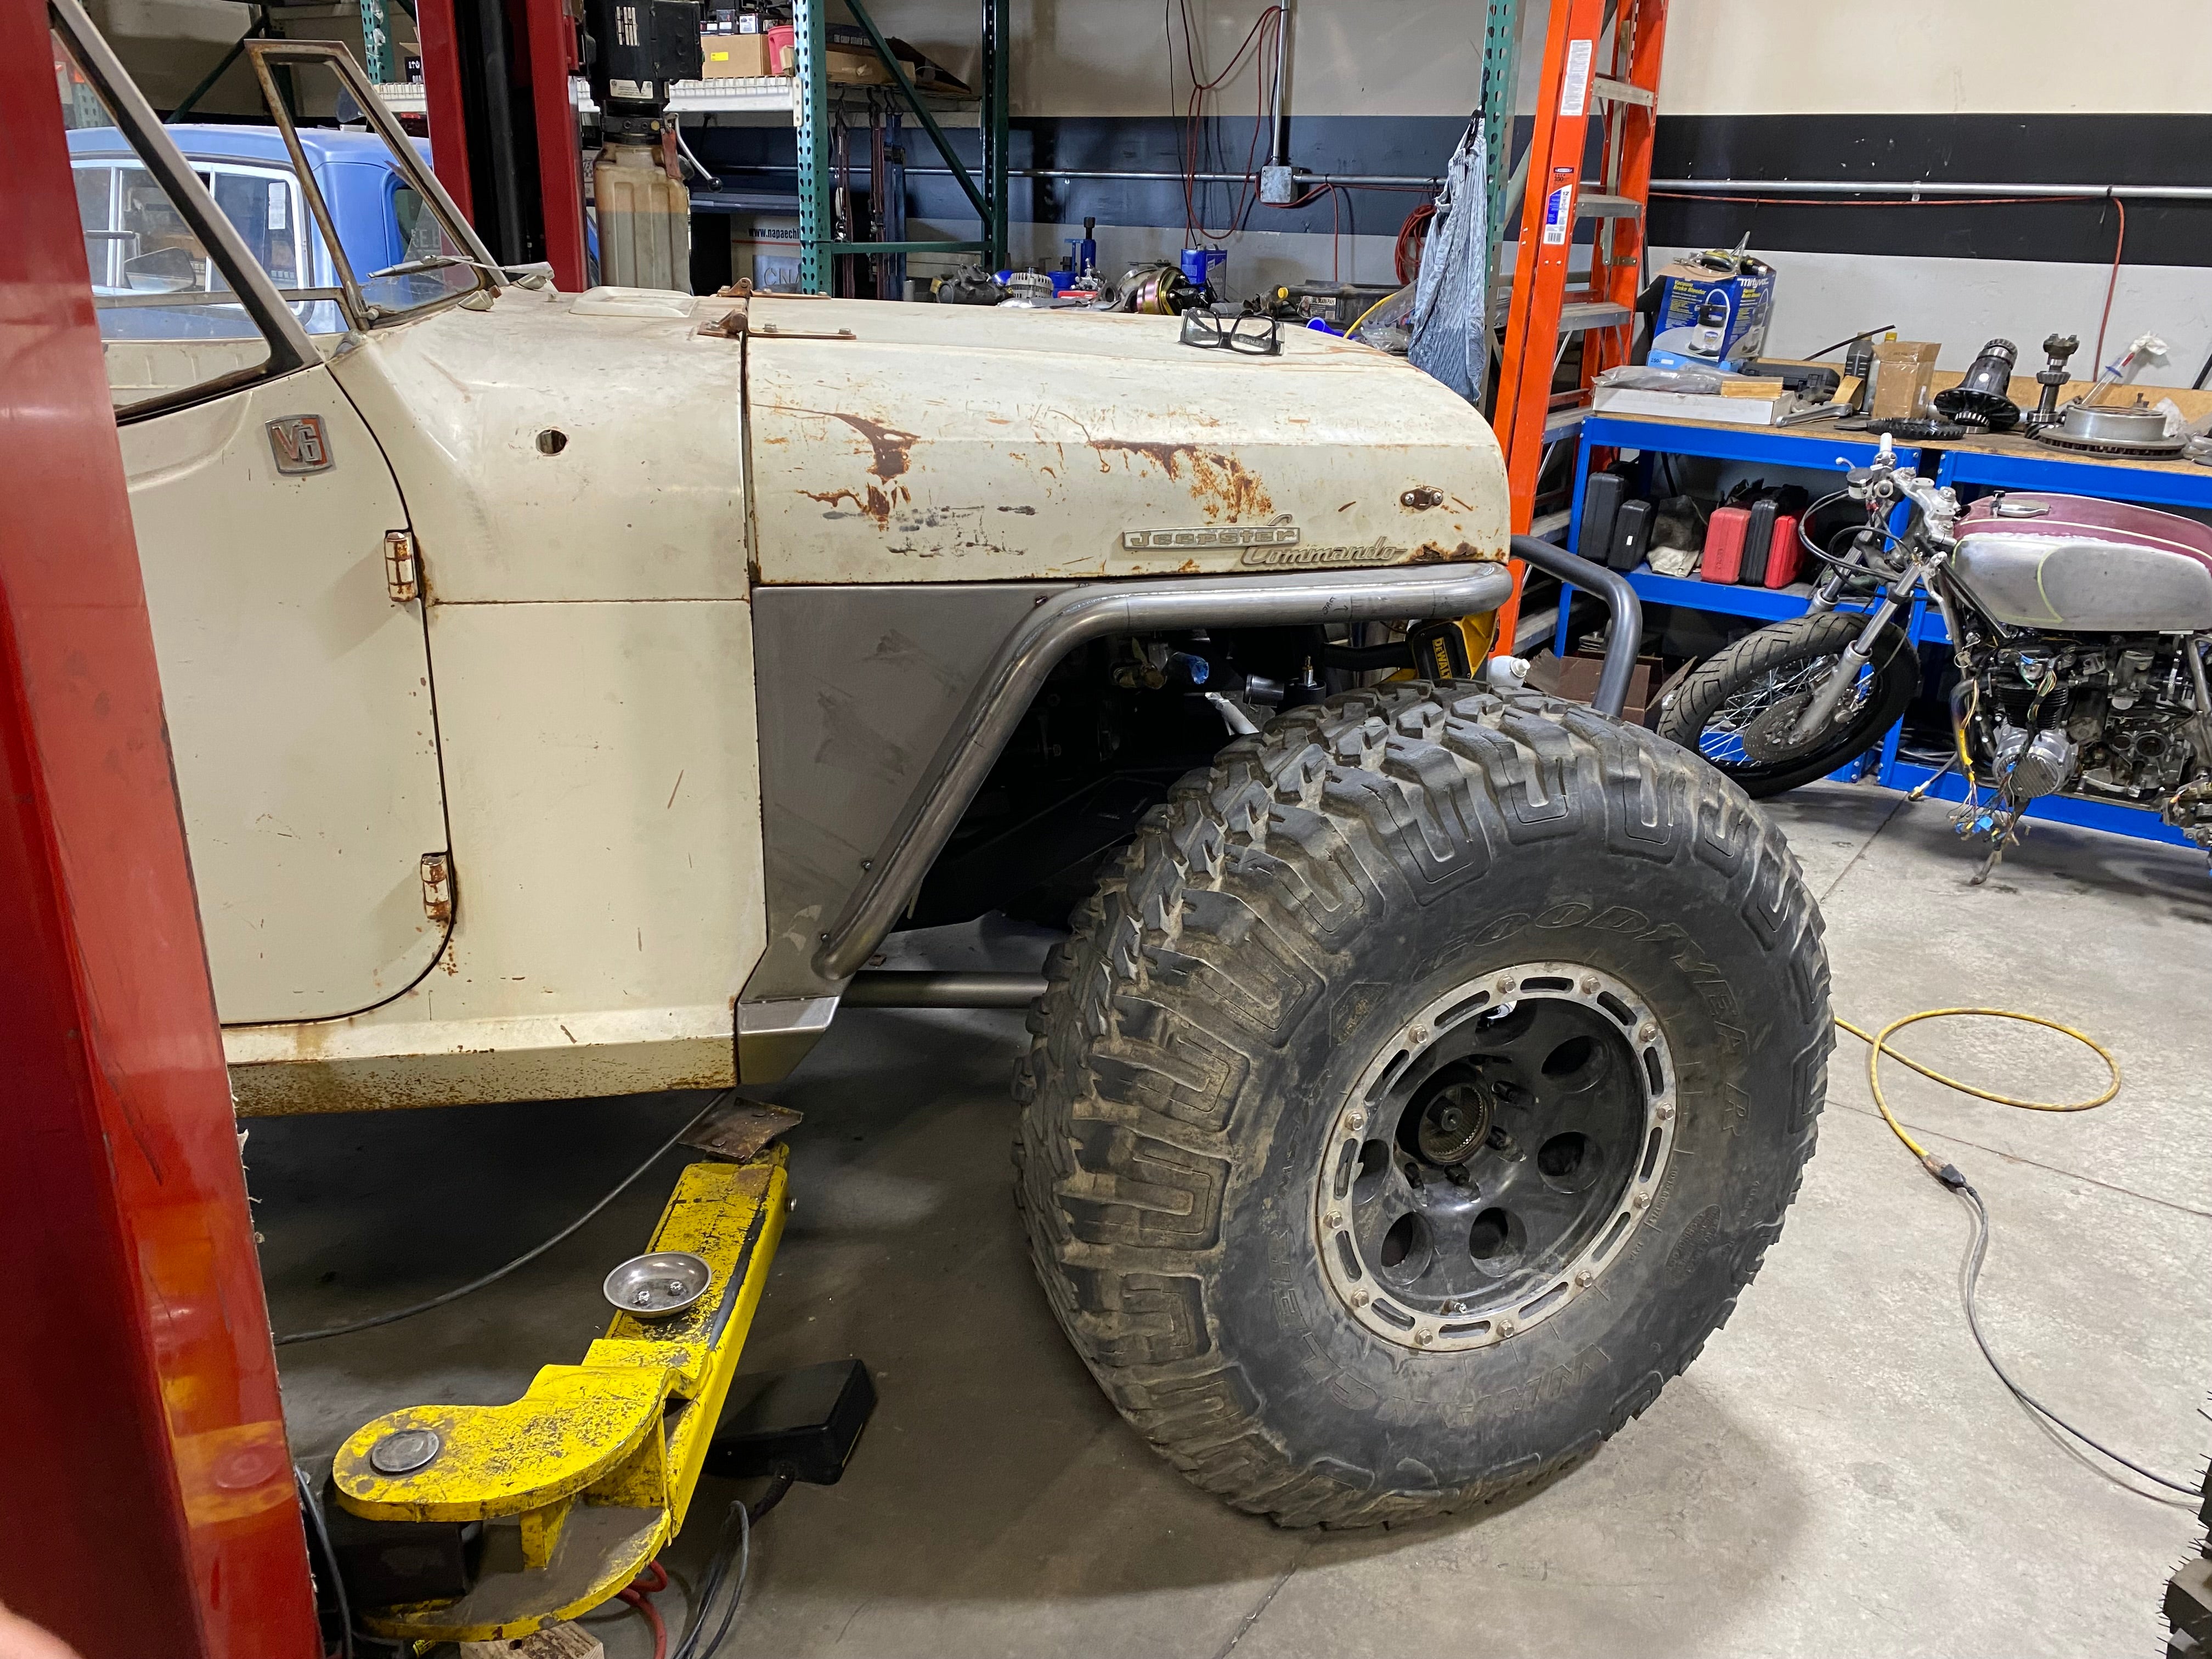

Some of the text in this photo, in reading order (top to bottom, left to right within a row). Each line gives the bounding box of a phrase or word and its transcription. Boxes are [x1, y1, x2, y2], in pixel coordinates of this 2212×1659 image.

[748, 228, 799, 239] www.napaechl
[272, 424, 322, 463] V6
[1131, 529, 1297, 546] Jeepster
[1241, 515, 1407, 564] Commando
